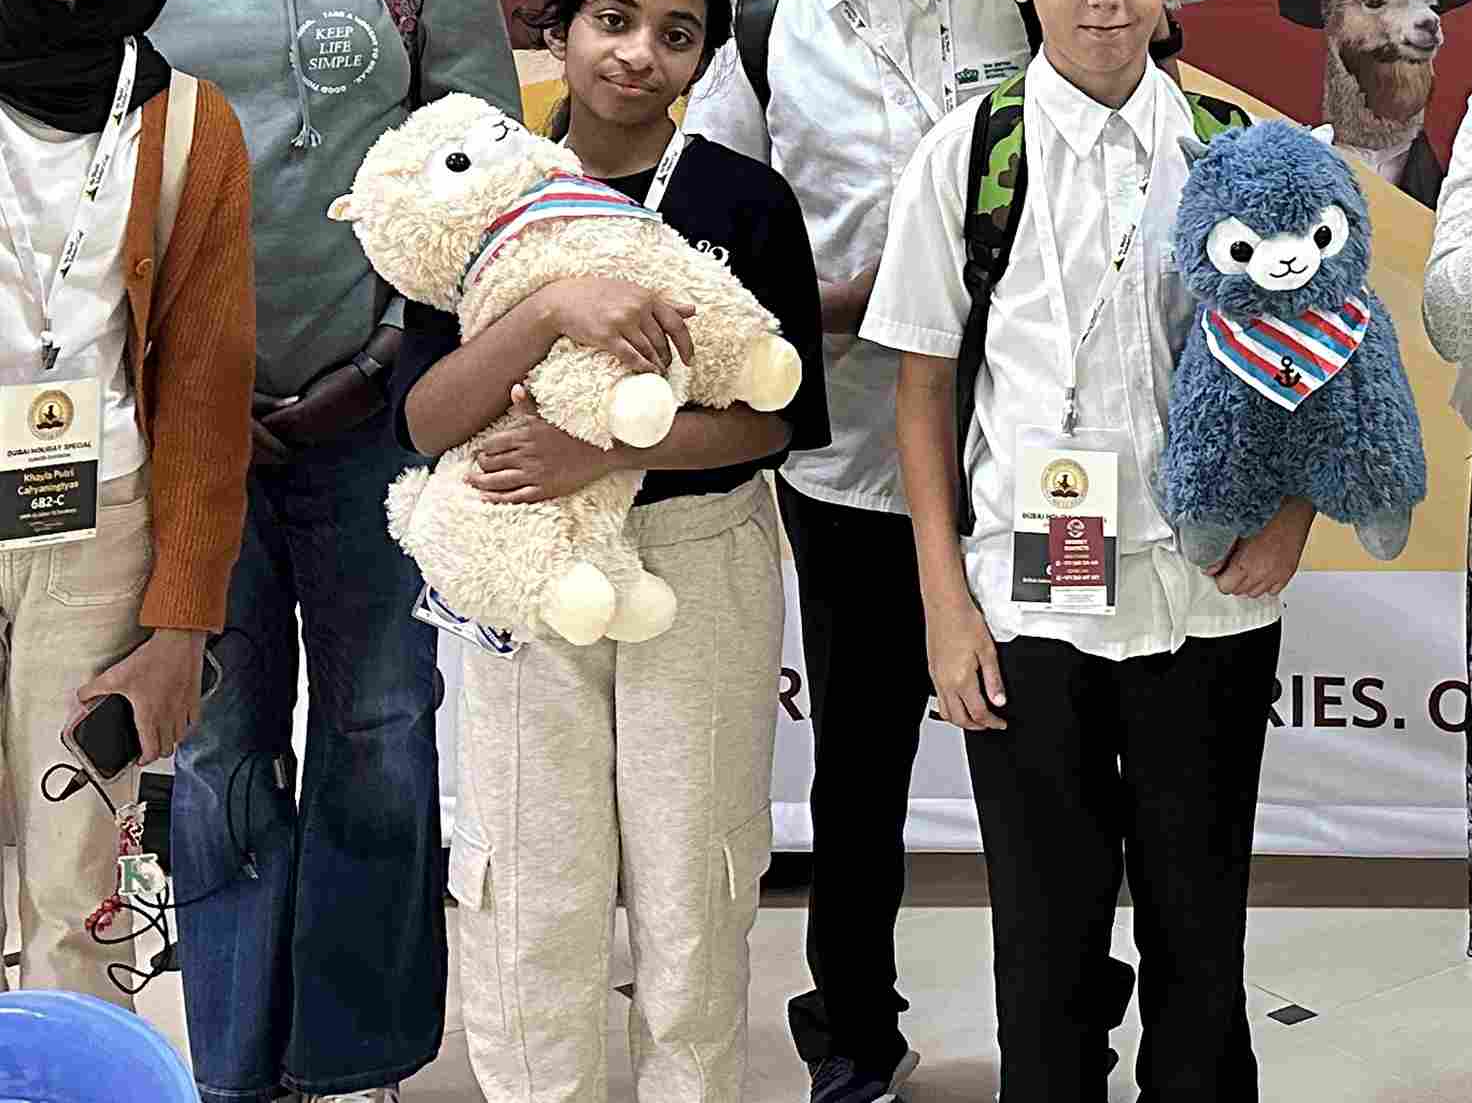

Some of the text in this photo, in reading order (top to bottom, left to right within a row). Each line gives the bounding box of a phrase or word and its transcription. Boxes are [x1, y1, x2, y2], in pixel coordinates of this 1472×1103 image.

[316, 26, 354, 40] KEEP
[320, 40, 351, 54] LIFE
[308, 54, 363, 70] SIMPLE
[30, 494, 65, 510] 682-C
